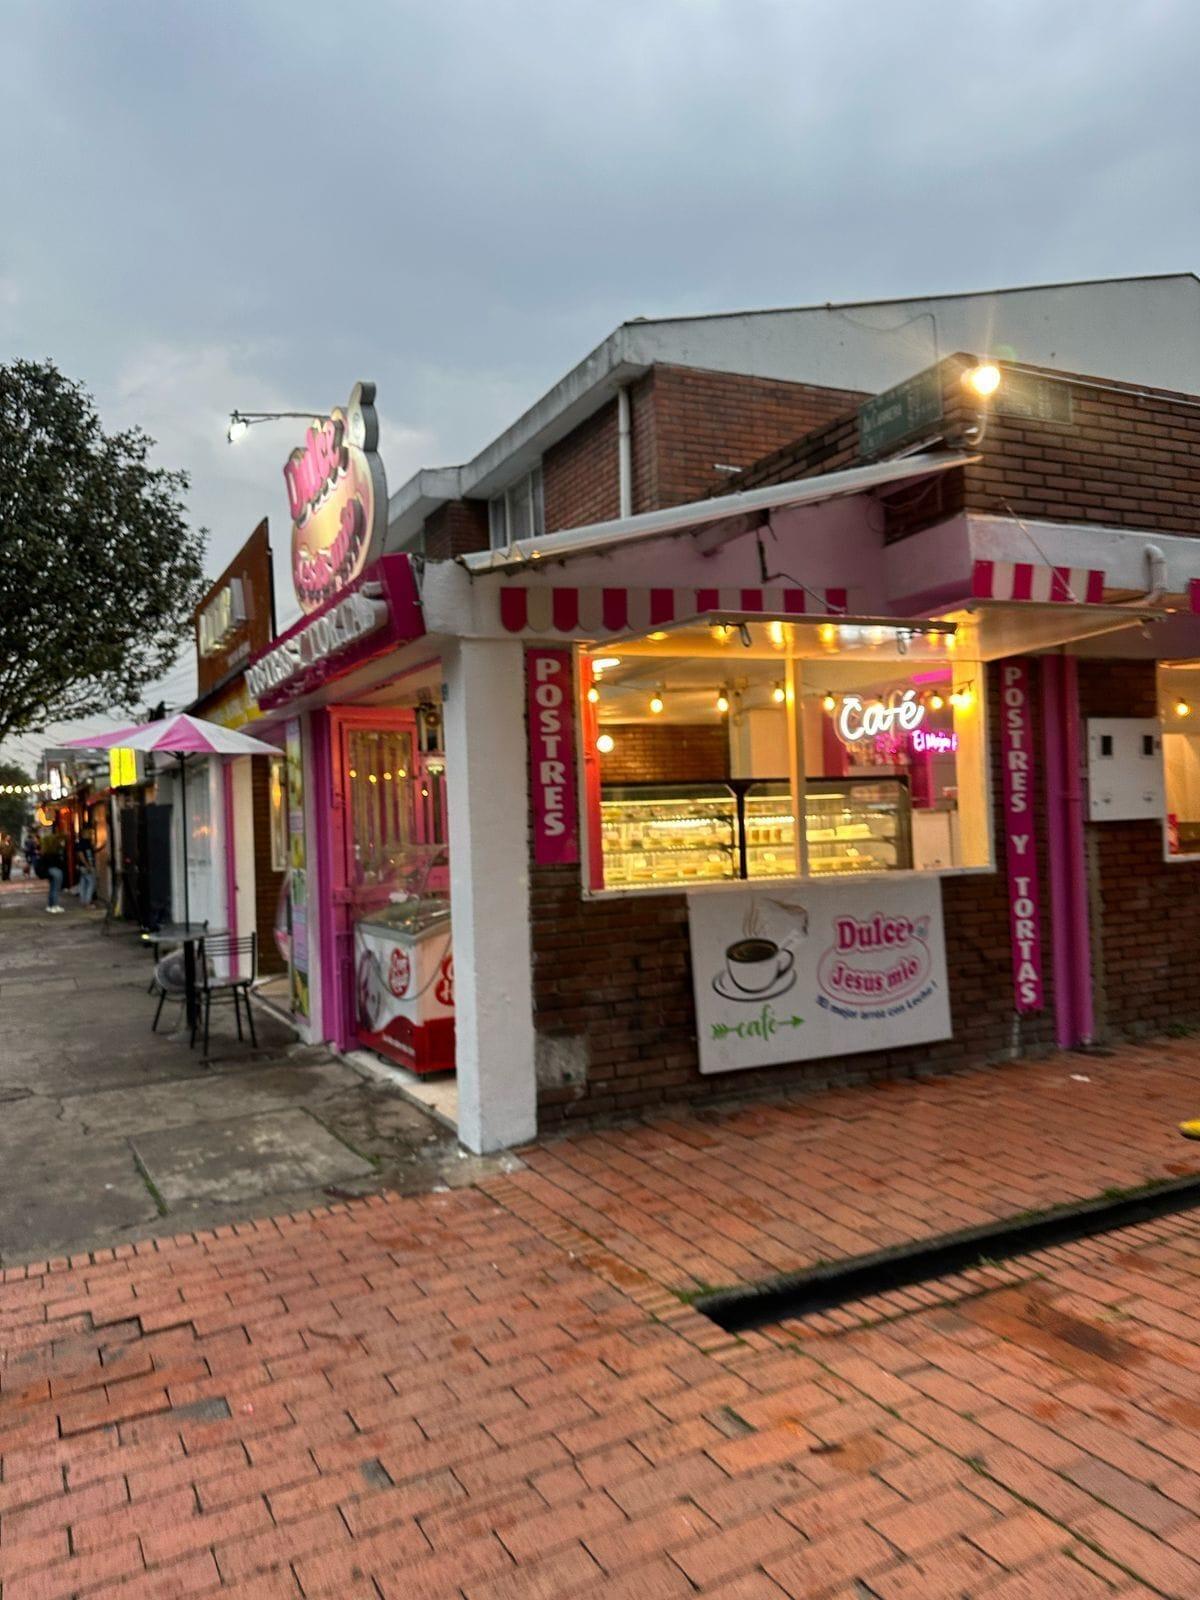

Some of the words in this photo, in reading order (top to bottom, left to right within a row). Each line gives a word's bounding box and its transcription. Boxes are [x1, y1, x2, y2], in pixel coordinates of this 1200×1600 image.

[535, 658, 566, 837] POSTRES
[1005, 666, 1029, 813] POSTRES
[1010, 834, 1029, 855] Y
[837, 917, 909, 949] Dulce
[1014, 876, 1038, 1003] TORTAS
